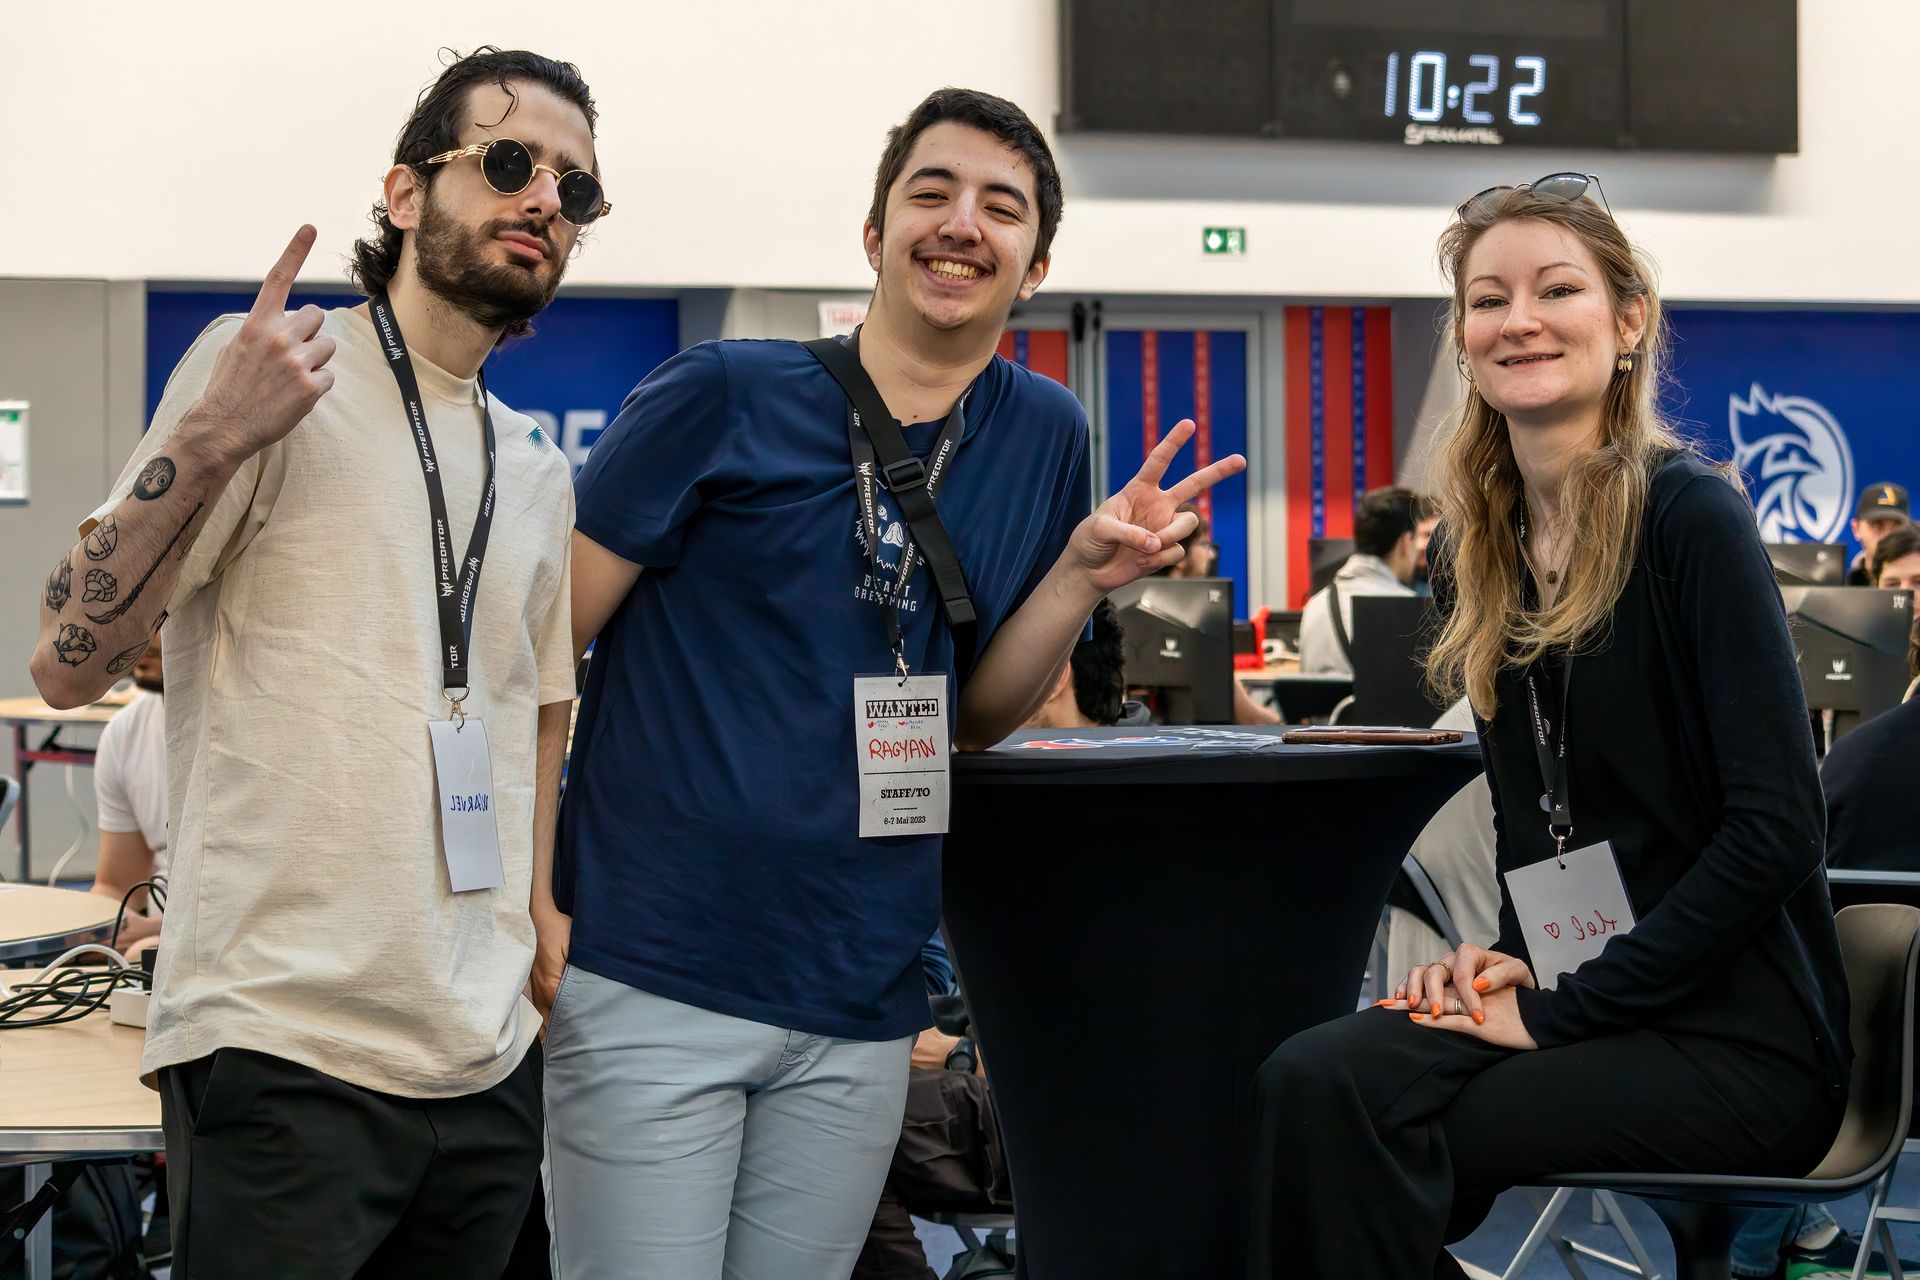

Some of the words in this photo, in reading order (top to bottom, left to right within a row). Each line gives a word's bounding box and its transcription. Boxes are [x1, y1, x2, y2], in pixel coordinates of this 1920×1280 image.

[1384, 51, 1546, 125] 10:22
[410, 401, 430, 457] PREDATOR
[927, 438, 953, 491] PREDATOR
[863, 477, 875, 534] PREDATOR
[437, 519, 449, 580] PREDATOR
[866, 700, 938, 718] WANTED
[880, 787, 930, 799] STAFF/TO
[883, 817, 895, 825] 6-7
[896, 816, 909, 825] Mai
[910, 816, 926, 824] 2023
